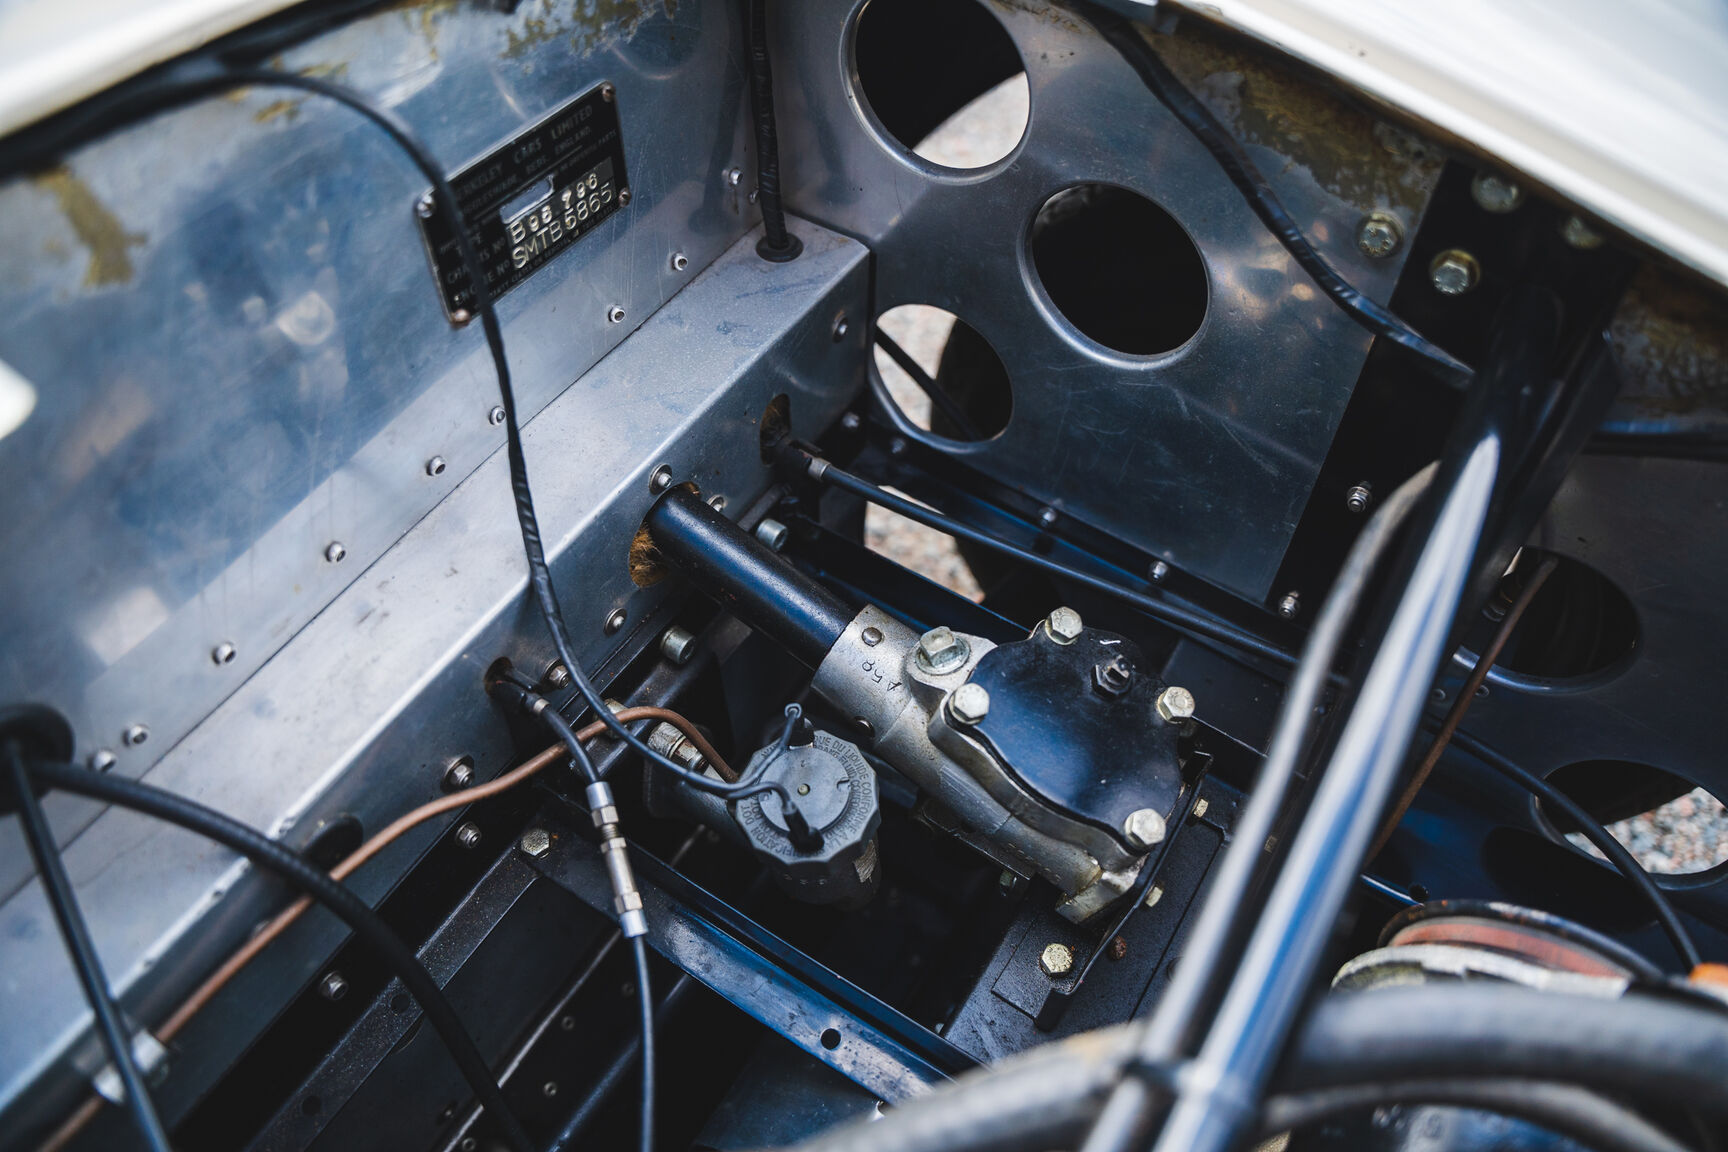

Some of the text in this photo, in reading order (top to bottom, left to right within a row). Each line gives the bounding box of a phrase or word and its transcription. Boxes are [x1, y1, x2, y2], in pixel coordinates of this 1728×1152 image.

[455, 163, 503, 202] ERKELEY
[514, 139, 541, 164] CARS
[551, 105, 592, 139] LIMITED
[448, 247, 490, 284] CHAIS
[455, 271, 494, 304] ENGE
[831, 740, 846, 752] DU
[837, 755, 857, 778] FLUID
[844, 748, 869, 780] LIQUIDE
[739, 805, 755, 826] DOT
[848, 781, 871, 835] CONFORME
